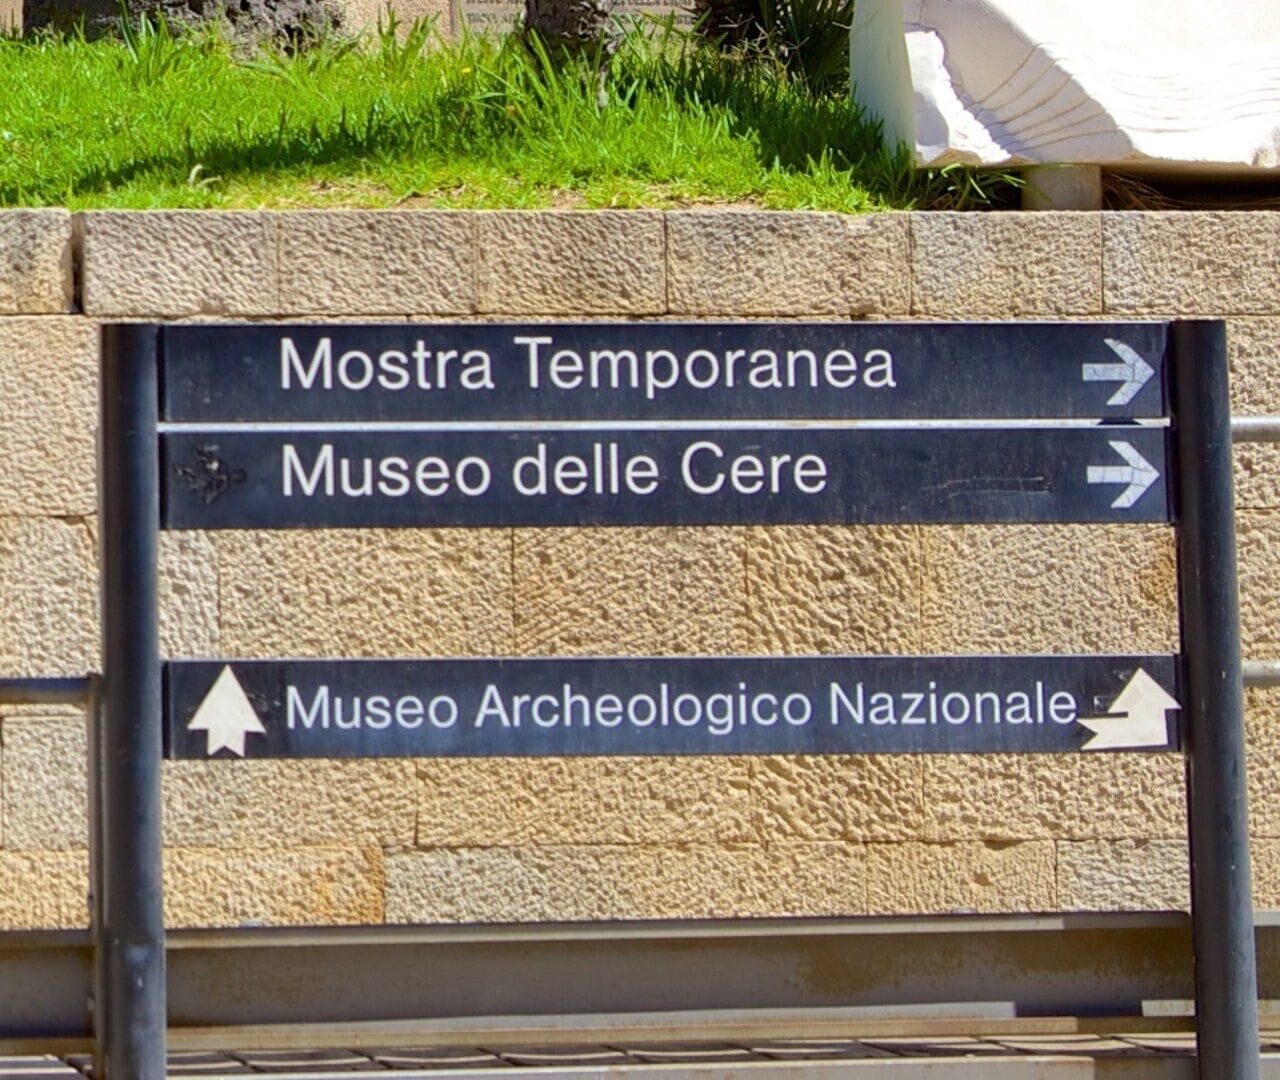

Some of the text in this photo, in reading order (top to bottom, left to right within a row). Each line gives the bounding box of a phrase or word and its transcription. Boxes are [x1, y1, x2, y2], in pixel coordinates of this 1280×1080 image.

[280, 336, 897, 400] Mostra Temporanea
[282, 441, 828, 497] Museo delle Cere
[285, 680, 1077, 736] Museo Archeologico Nazionale
